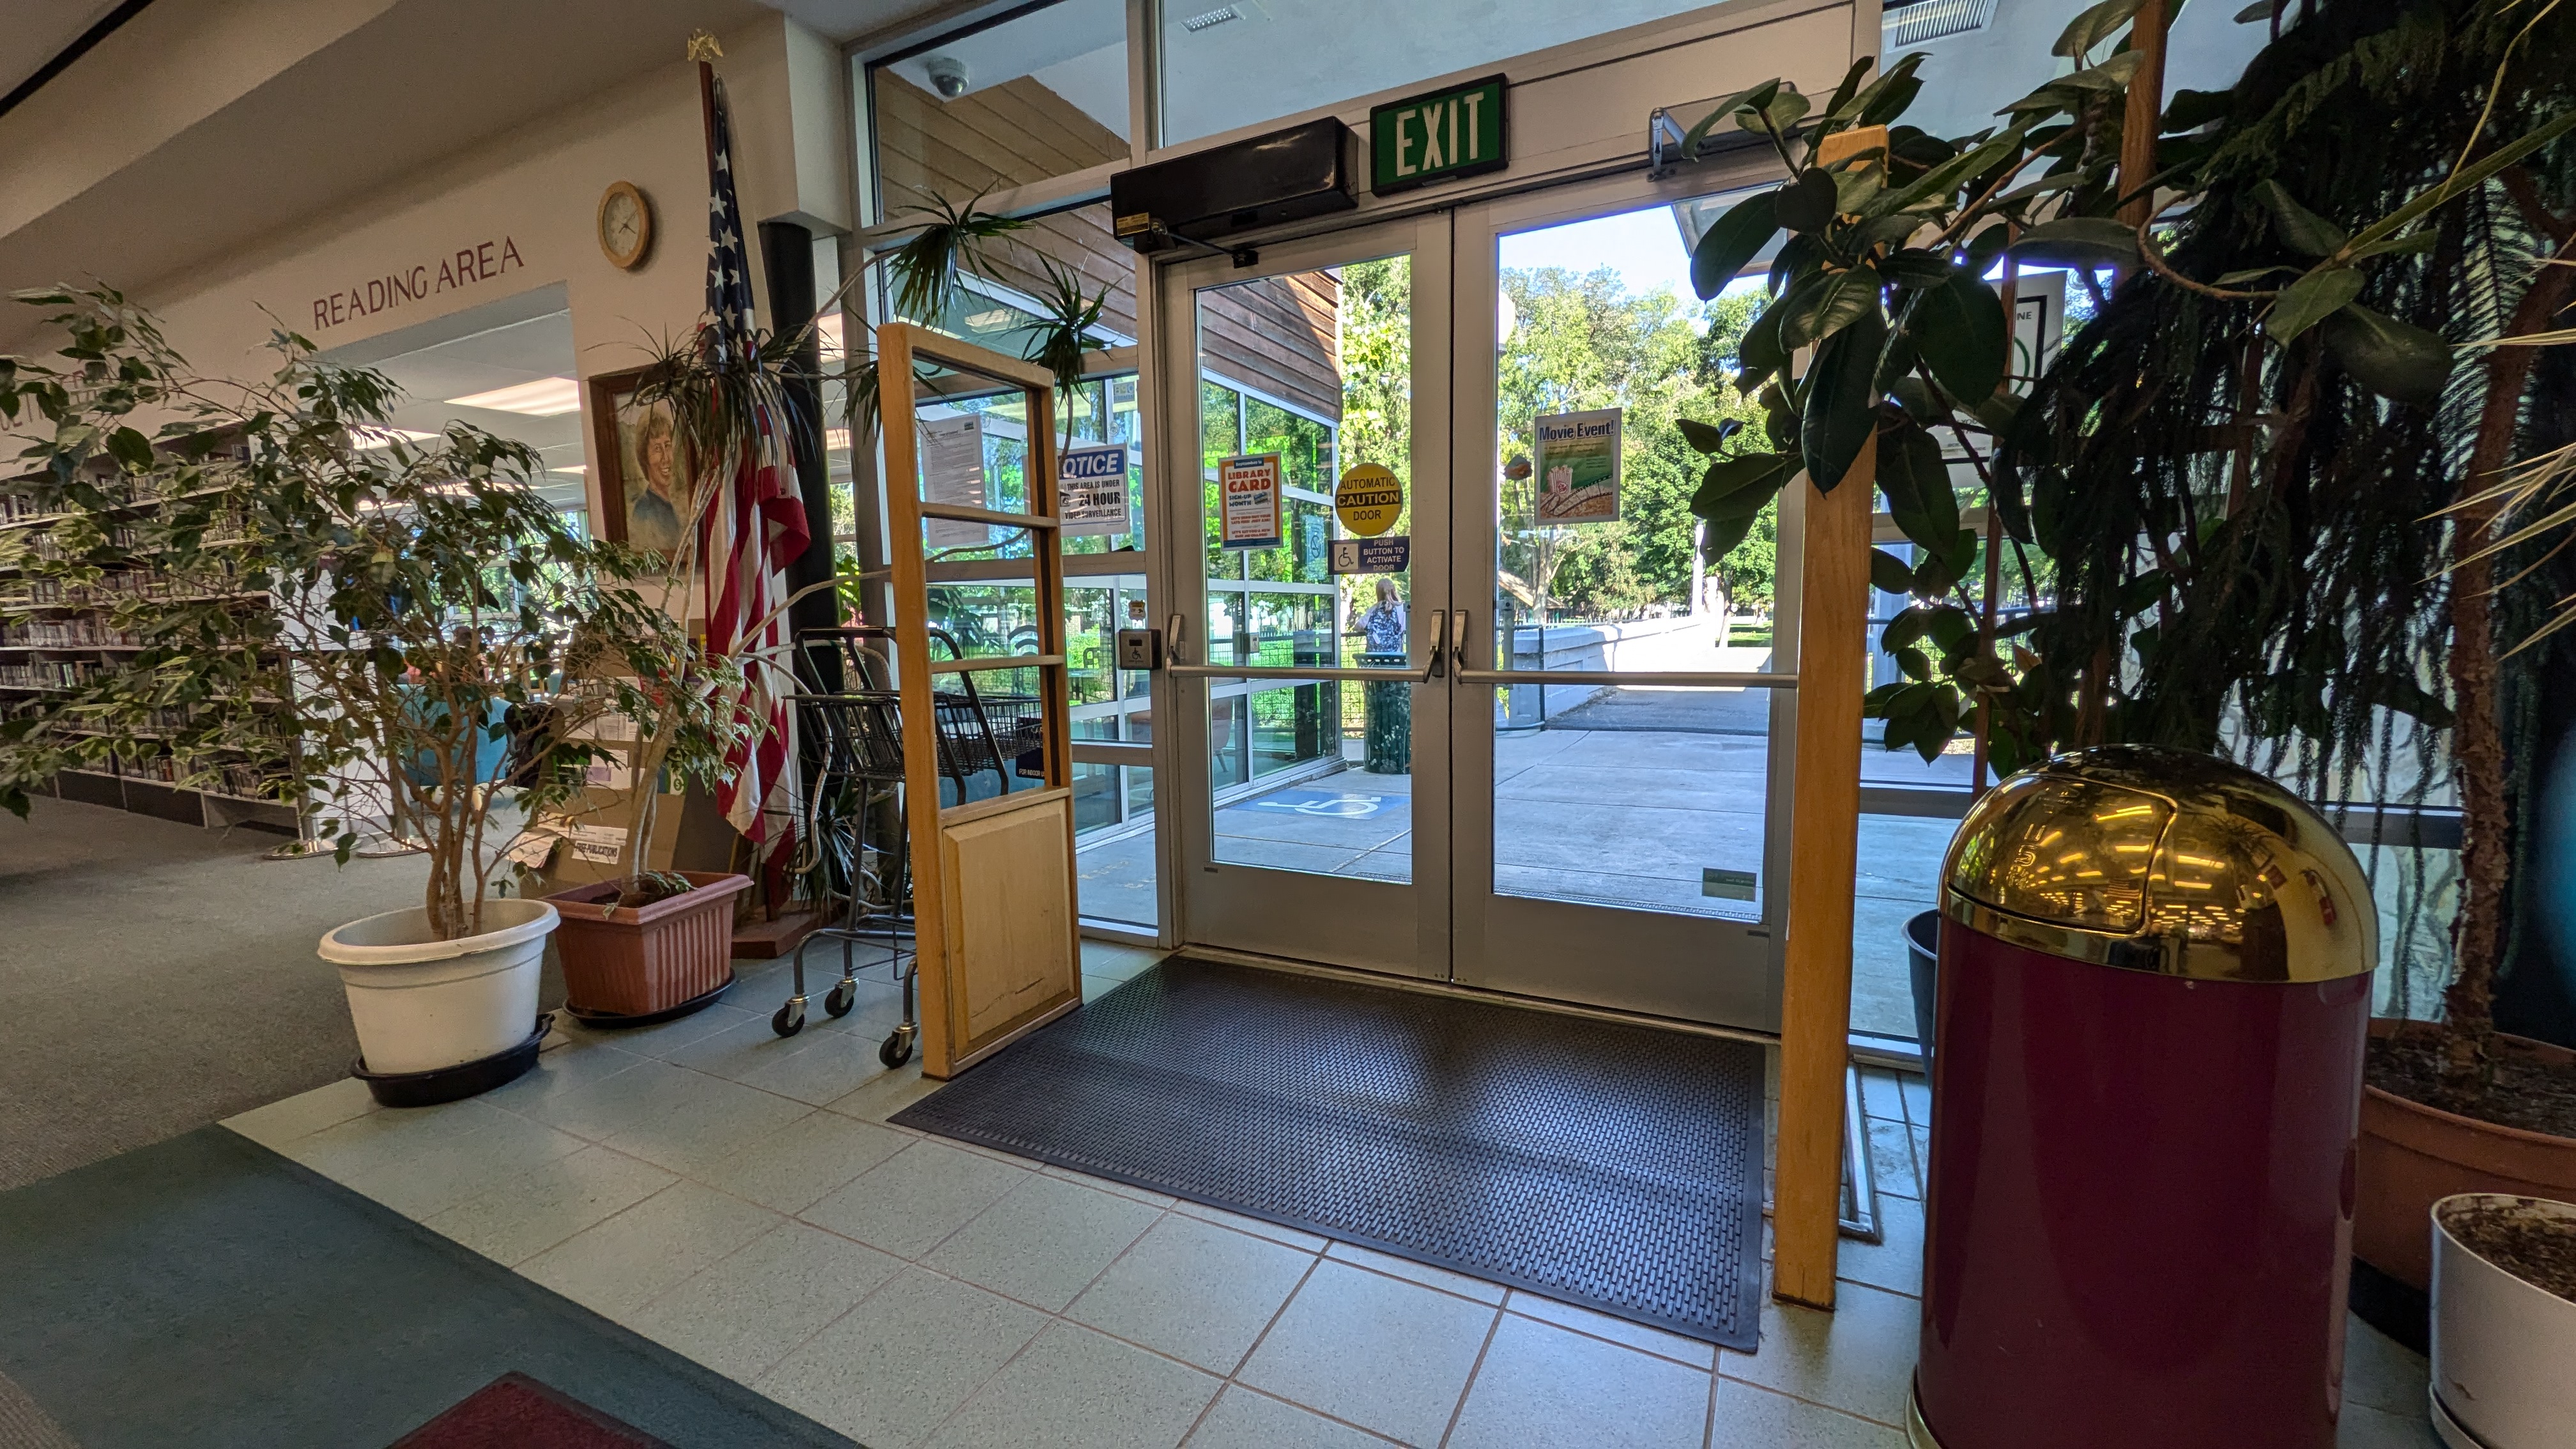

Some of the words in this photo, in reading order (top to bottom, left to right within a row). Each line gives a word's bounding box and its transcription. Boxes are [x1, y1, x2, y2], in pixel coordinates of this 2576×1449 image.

[1397, 92, 1484, 176] EXIT
[313, 266, 427, 330] READING
[435, 236, 524, 293] AREA
[2016, 312, 2032, 320] NE
[1539, 425, 1574, 441] Movie
[1577, 420, 1614, 437] Event!
[1062, 453, 1119, 475] OTICE
[1228, 468, 1271, 480] LIBRARY
[1080, 481, 1094, 489] AREA
[1101, 479, 1120, 487] UNDER
[1229, 478, 1271, 493] CARD
[1340, 477, 1395, 490] AUTOMATIC
[1078, 494, 1091, 506] 24
[1093, 492, 1121, 505] HOUR
[1337, 492, 1399, 506] CAUTION
[1065, 511, 1080, 519] VIDEO
[1082, 509, 1121, 518] SURVEILLANCE
[1353, 510, 1381, 521] DOOR
[1367, 555, 1402, 564] ACTIVATE
